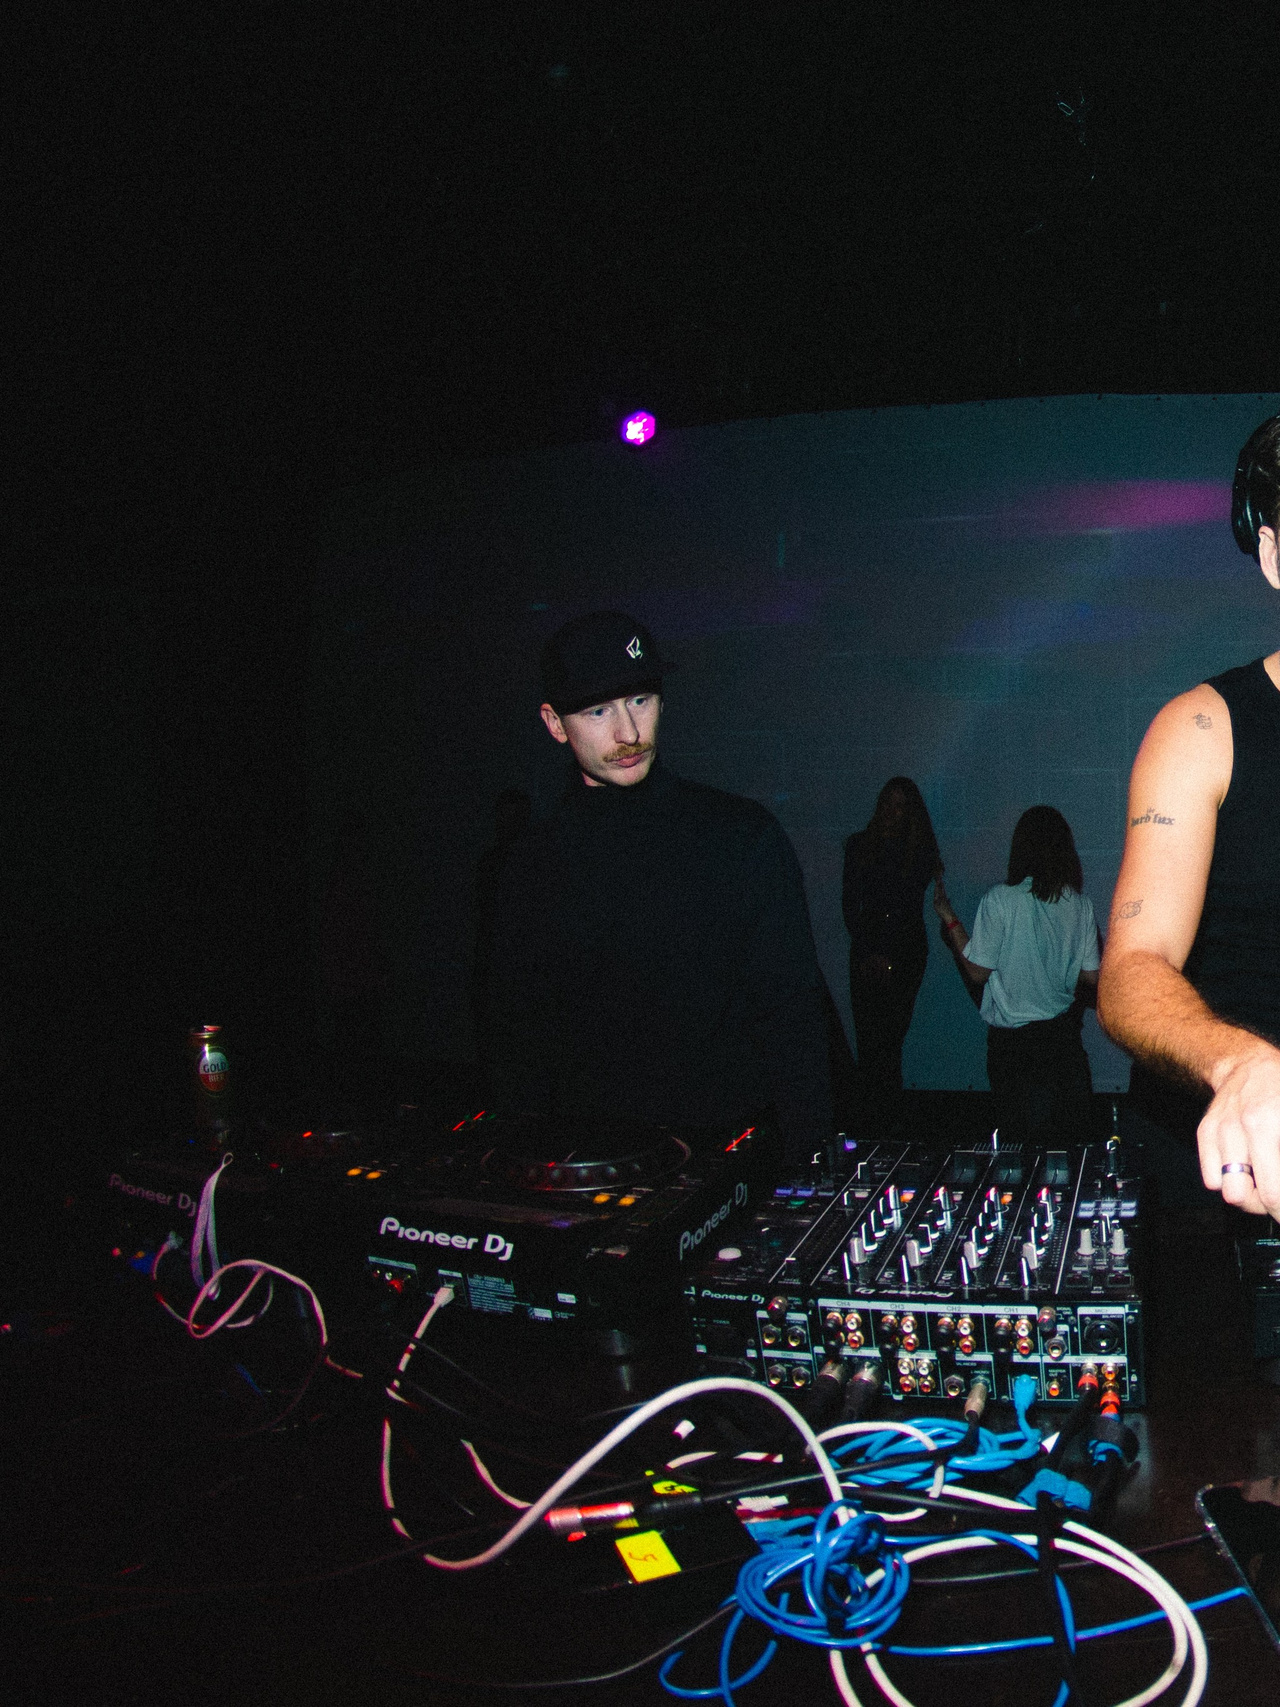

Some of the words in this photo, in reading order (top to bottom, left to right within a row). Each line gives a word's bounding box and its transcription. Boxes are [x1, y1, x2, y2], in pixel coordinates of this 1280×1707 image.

[107, 1172, 173, 1206] Pioneer
[380, 1216, 479, 1250] Pioneer
[680, 1198, 733, 1260] Pioneer
[701, 1289, 749, 1301] Pioneer
[836, 1300, 851, 1308] CH4
[879, 1289, 954, 1298] Pioneer
